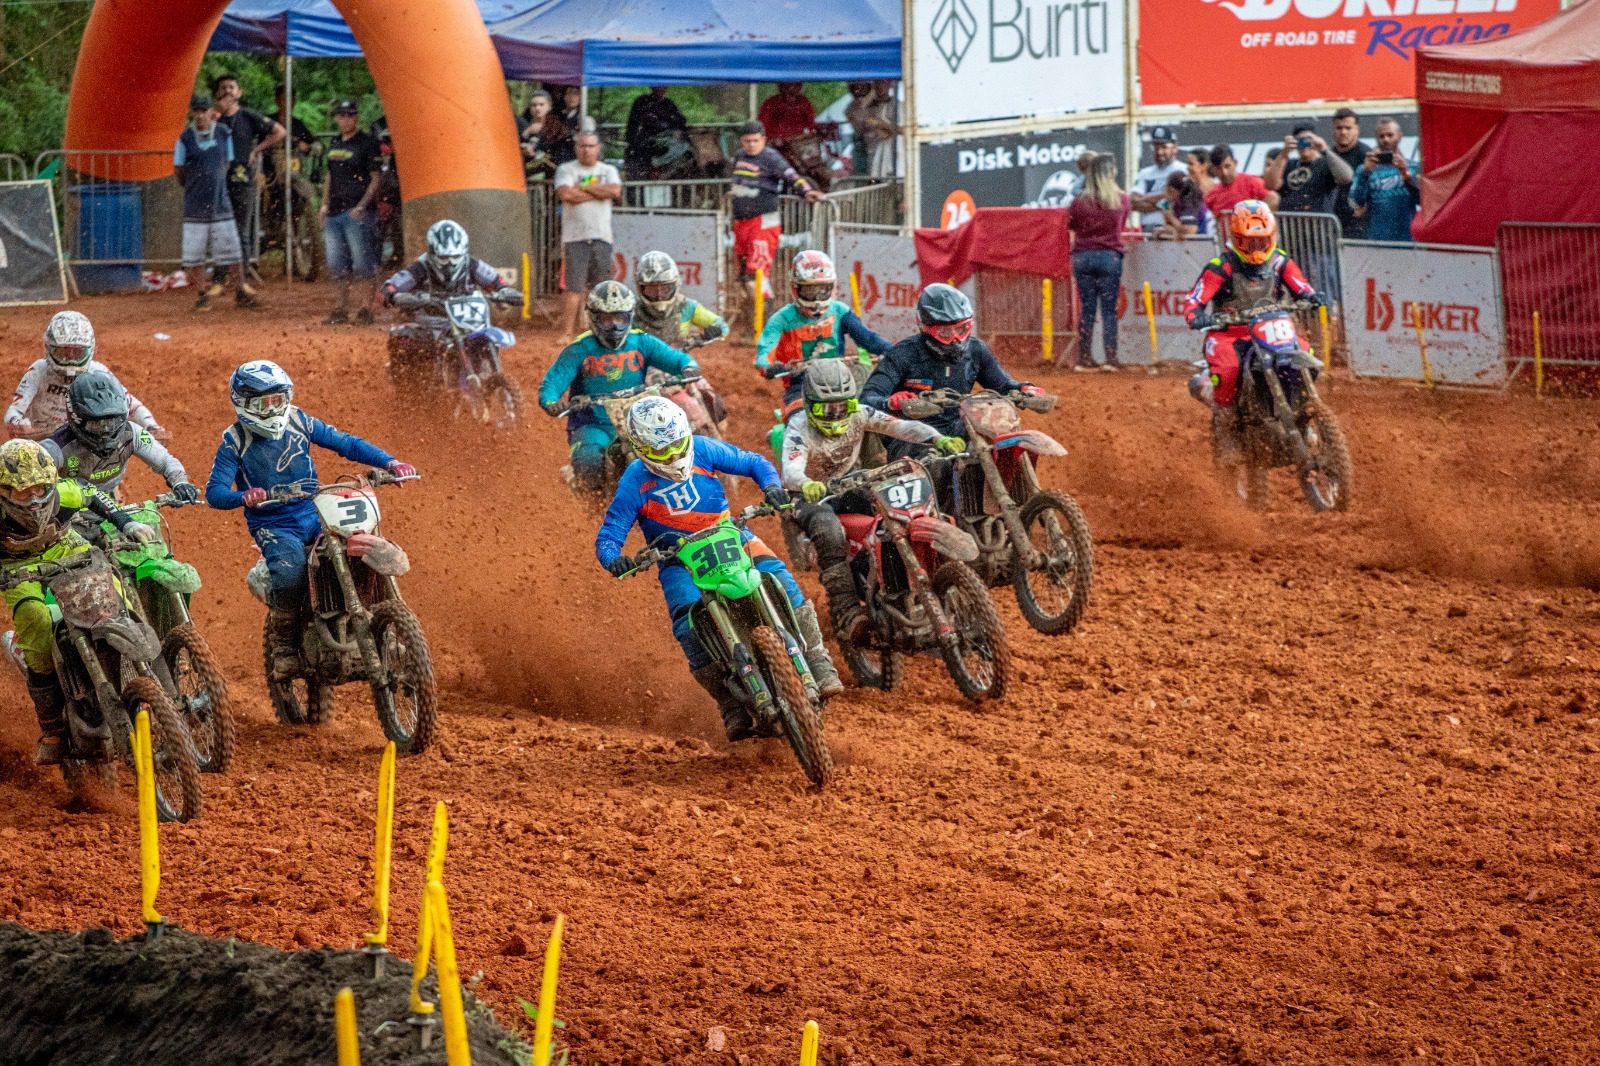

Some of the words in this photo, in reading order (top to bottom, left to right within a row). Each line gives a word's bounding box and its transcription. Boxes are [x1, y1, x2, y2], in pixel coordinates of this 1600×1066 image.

[1241, 32, 1272, 48] OFF
[1275, 31, 1318, 46] ROAD
[1323, 30, 1357, 45] TIRE
[958, 147, 1014, 173] Disk
[1258, 319, 1295, 344] 18
[887, 480, 922, 508] 97
[337, 499, 368, 527] 3
[691, 538, 741, 579] 36
